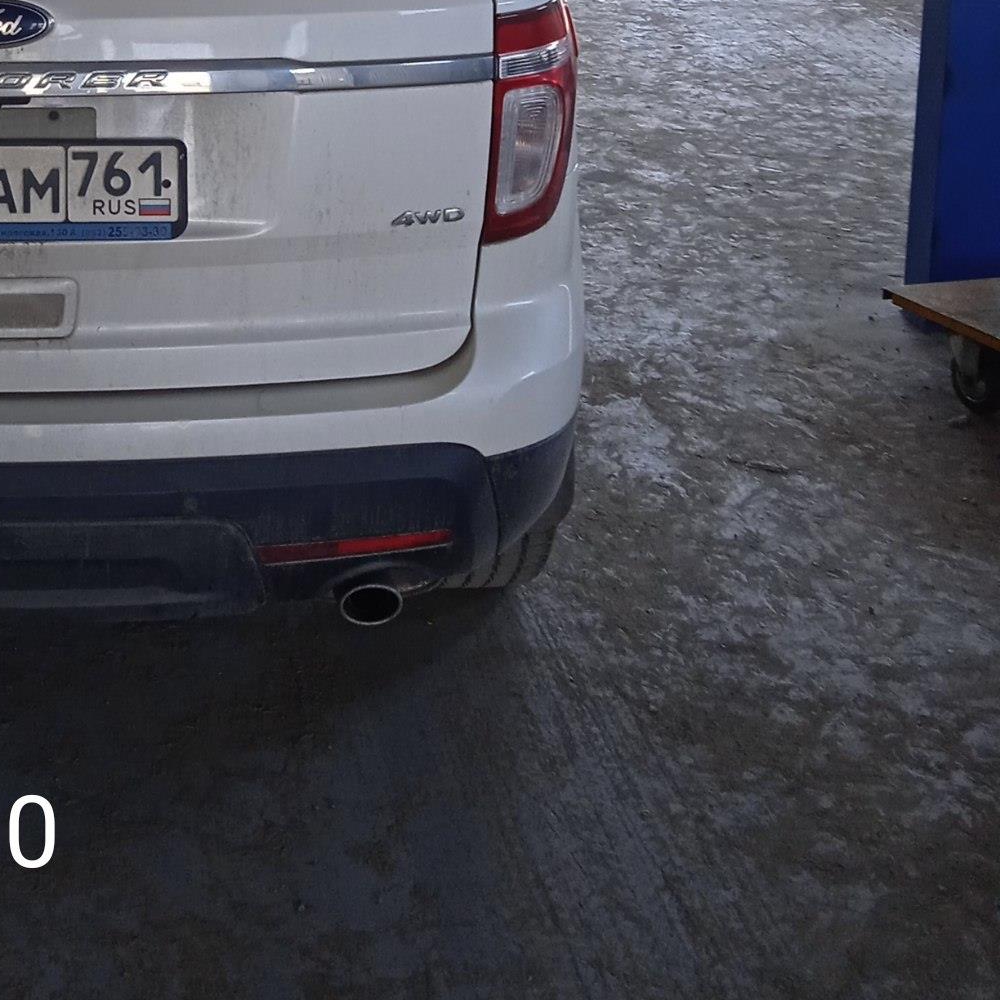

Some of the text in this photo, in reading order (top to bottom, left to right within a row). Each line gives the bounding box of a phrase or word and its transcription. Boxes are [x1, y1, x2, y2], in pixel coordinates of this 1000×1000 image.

[72, 151, 164, 197] 761
[92, 199, 136, 216] RUS
[391, 207, 465, 227] 4WD
